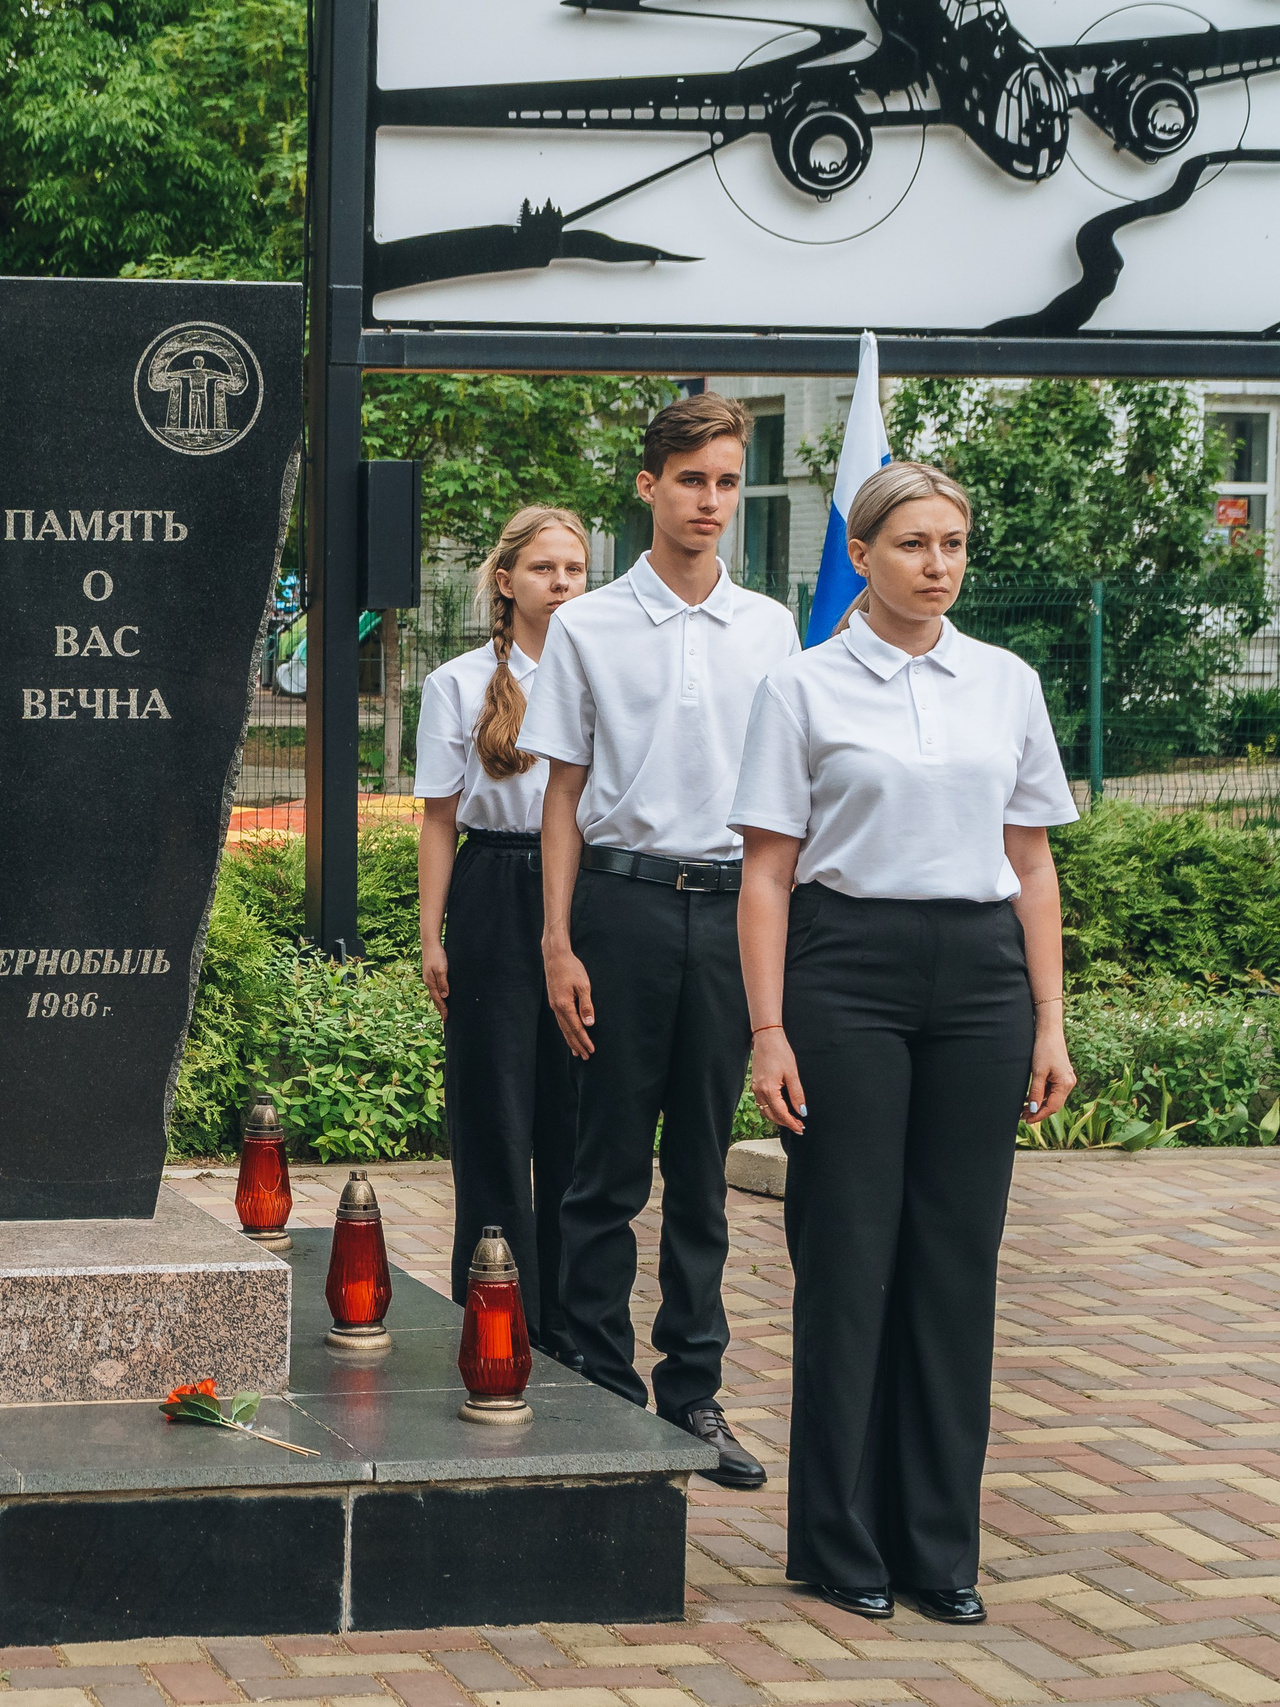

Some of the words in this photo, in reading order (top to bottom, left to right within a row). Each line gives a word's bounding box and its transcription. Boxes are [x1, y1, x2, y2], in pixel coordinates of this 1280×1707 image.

[4, 510, 187, 541] ПАМЯТЬ
[83, 570, 113, 601] О
[55, 626, 140, 656] ВАС
[22, 688, 171, 719] ВЕЧНА
[27, 993, 98, 1018] 1986
